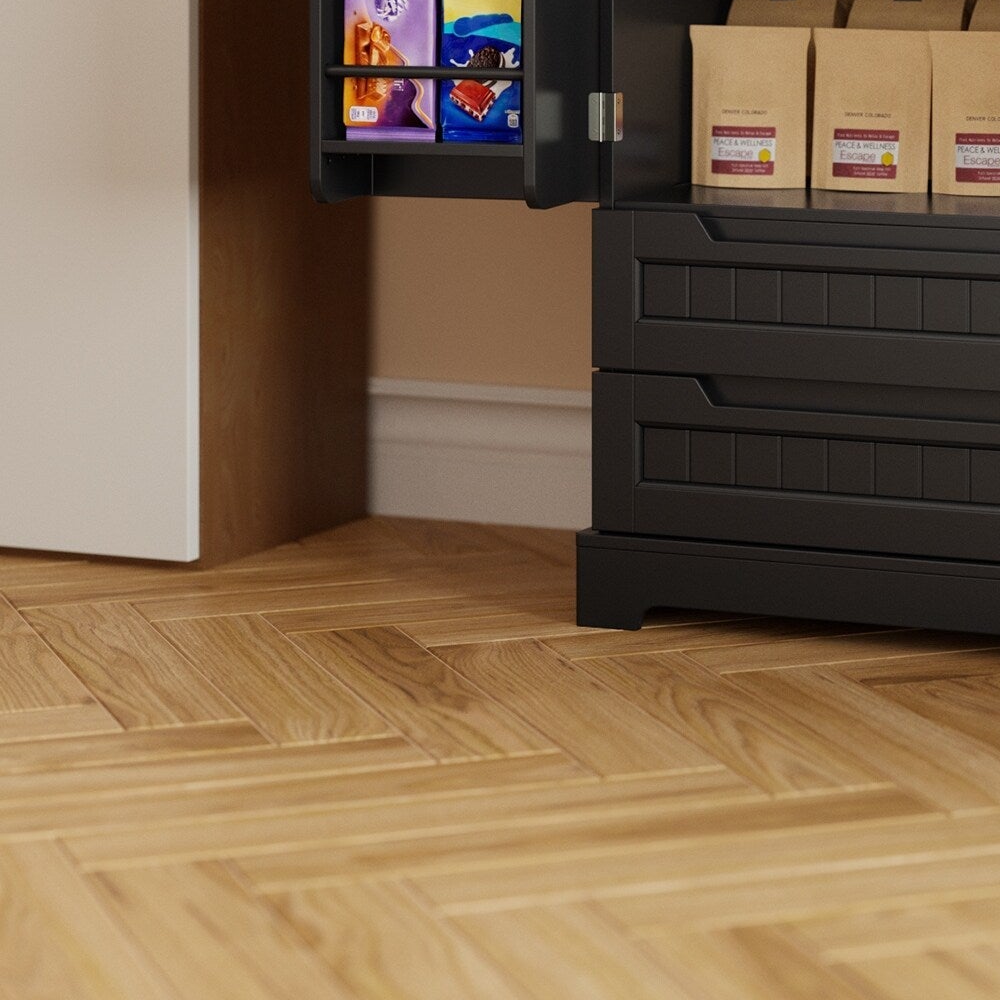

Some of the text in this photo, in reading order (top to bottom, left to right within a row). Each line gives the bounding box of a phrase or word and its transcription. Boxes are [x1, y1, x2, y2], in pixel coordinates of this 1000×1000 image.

[713, 138, 773, 147] PEACE & WELLNESS
[835, 141, 855, 149] PEACE
[863, 142, 896, 150] WELLNESS
[718, 147, 753, 159] Escape
[957, 146, 979, 154] PEACE
[980, 146, 985, 154] &
[840, 150, 876, 162] Escape
[963, 155, 1000, 167] Escape
